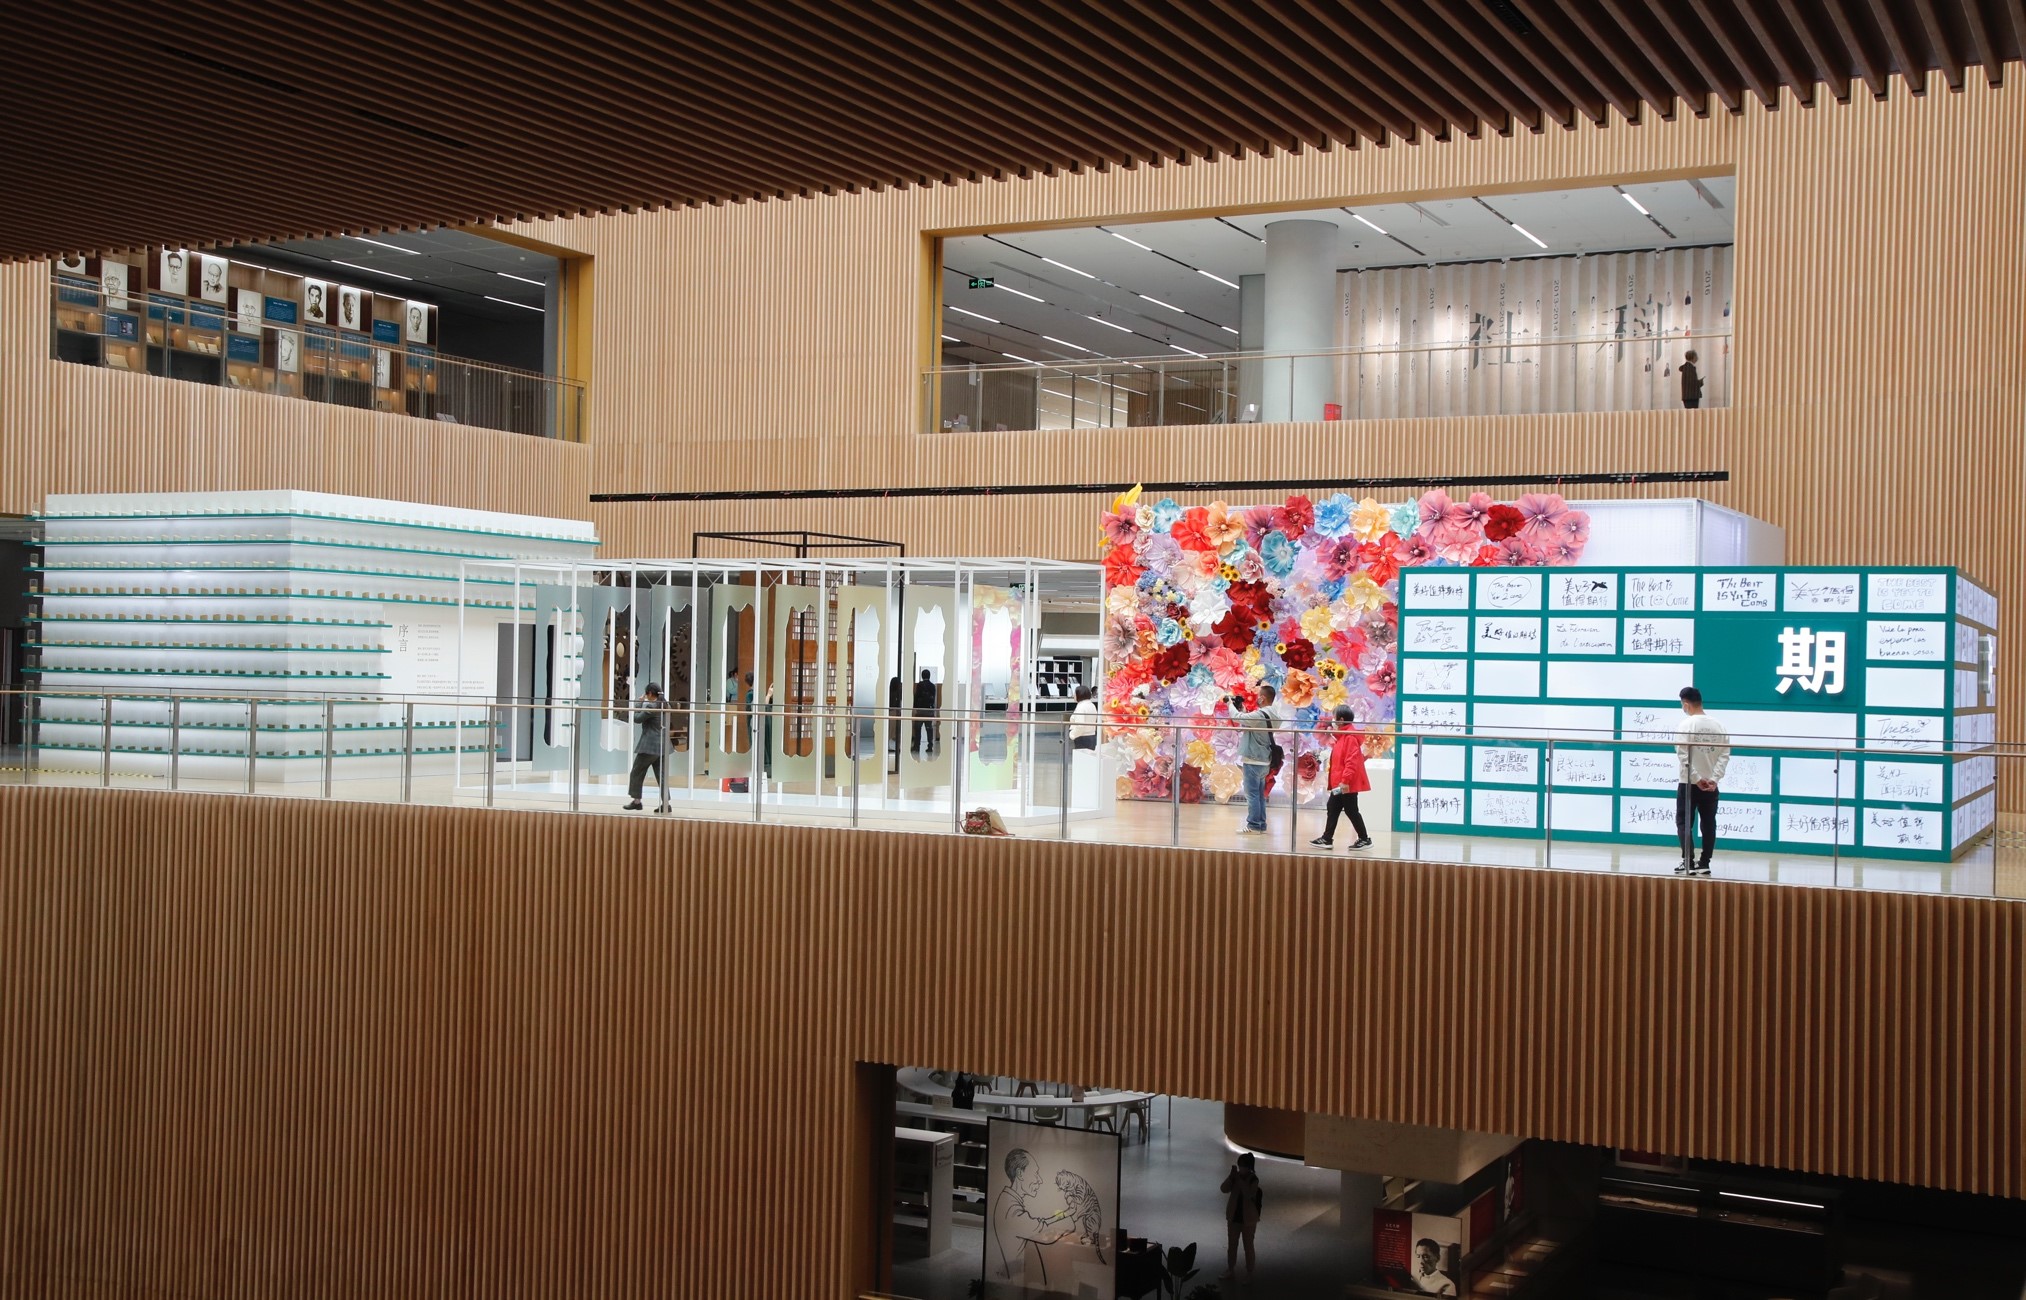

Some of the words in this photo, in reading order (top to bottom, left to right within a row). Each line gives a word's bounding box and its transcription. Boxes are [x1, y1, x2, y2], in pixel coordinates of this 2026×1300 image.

[1632, 577, 1646, 592] The
[1905, 578, 1936, 588] BEST
[1891, 587, 1915, 597] YET
[1631, 593, 1645, 608] Yet
[399, 624, 408, 651] 序言
[1631, 637, 1683, 654] 值得期待
[1775, 627, 1846, 694] 期
